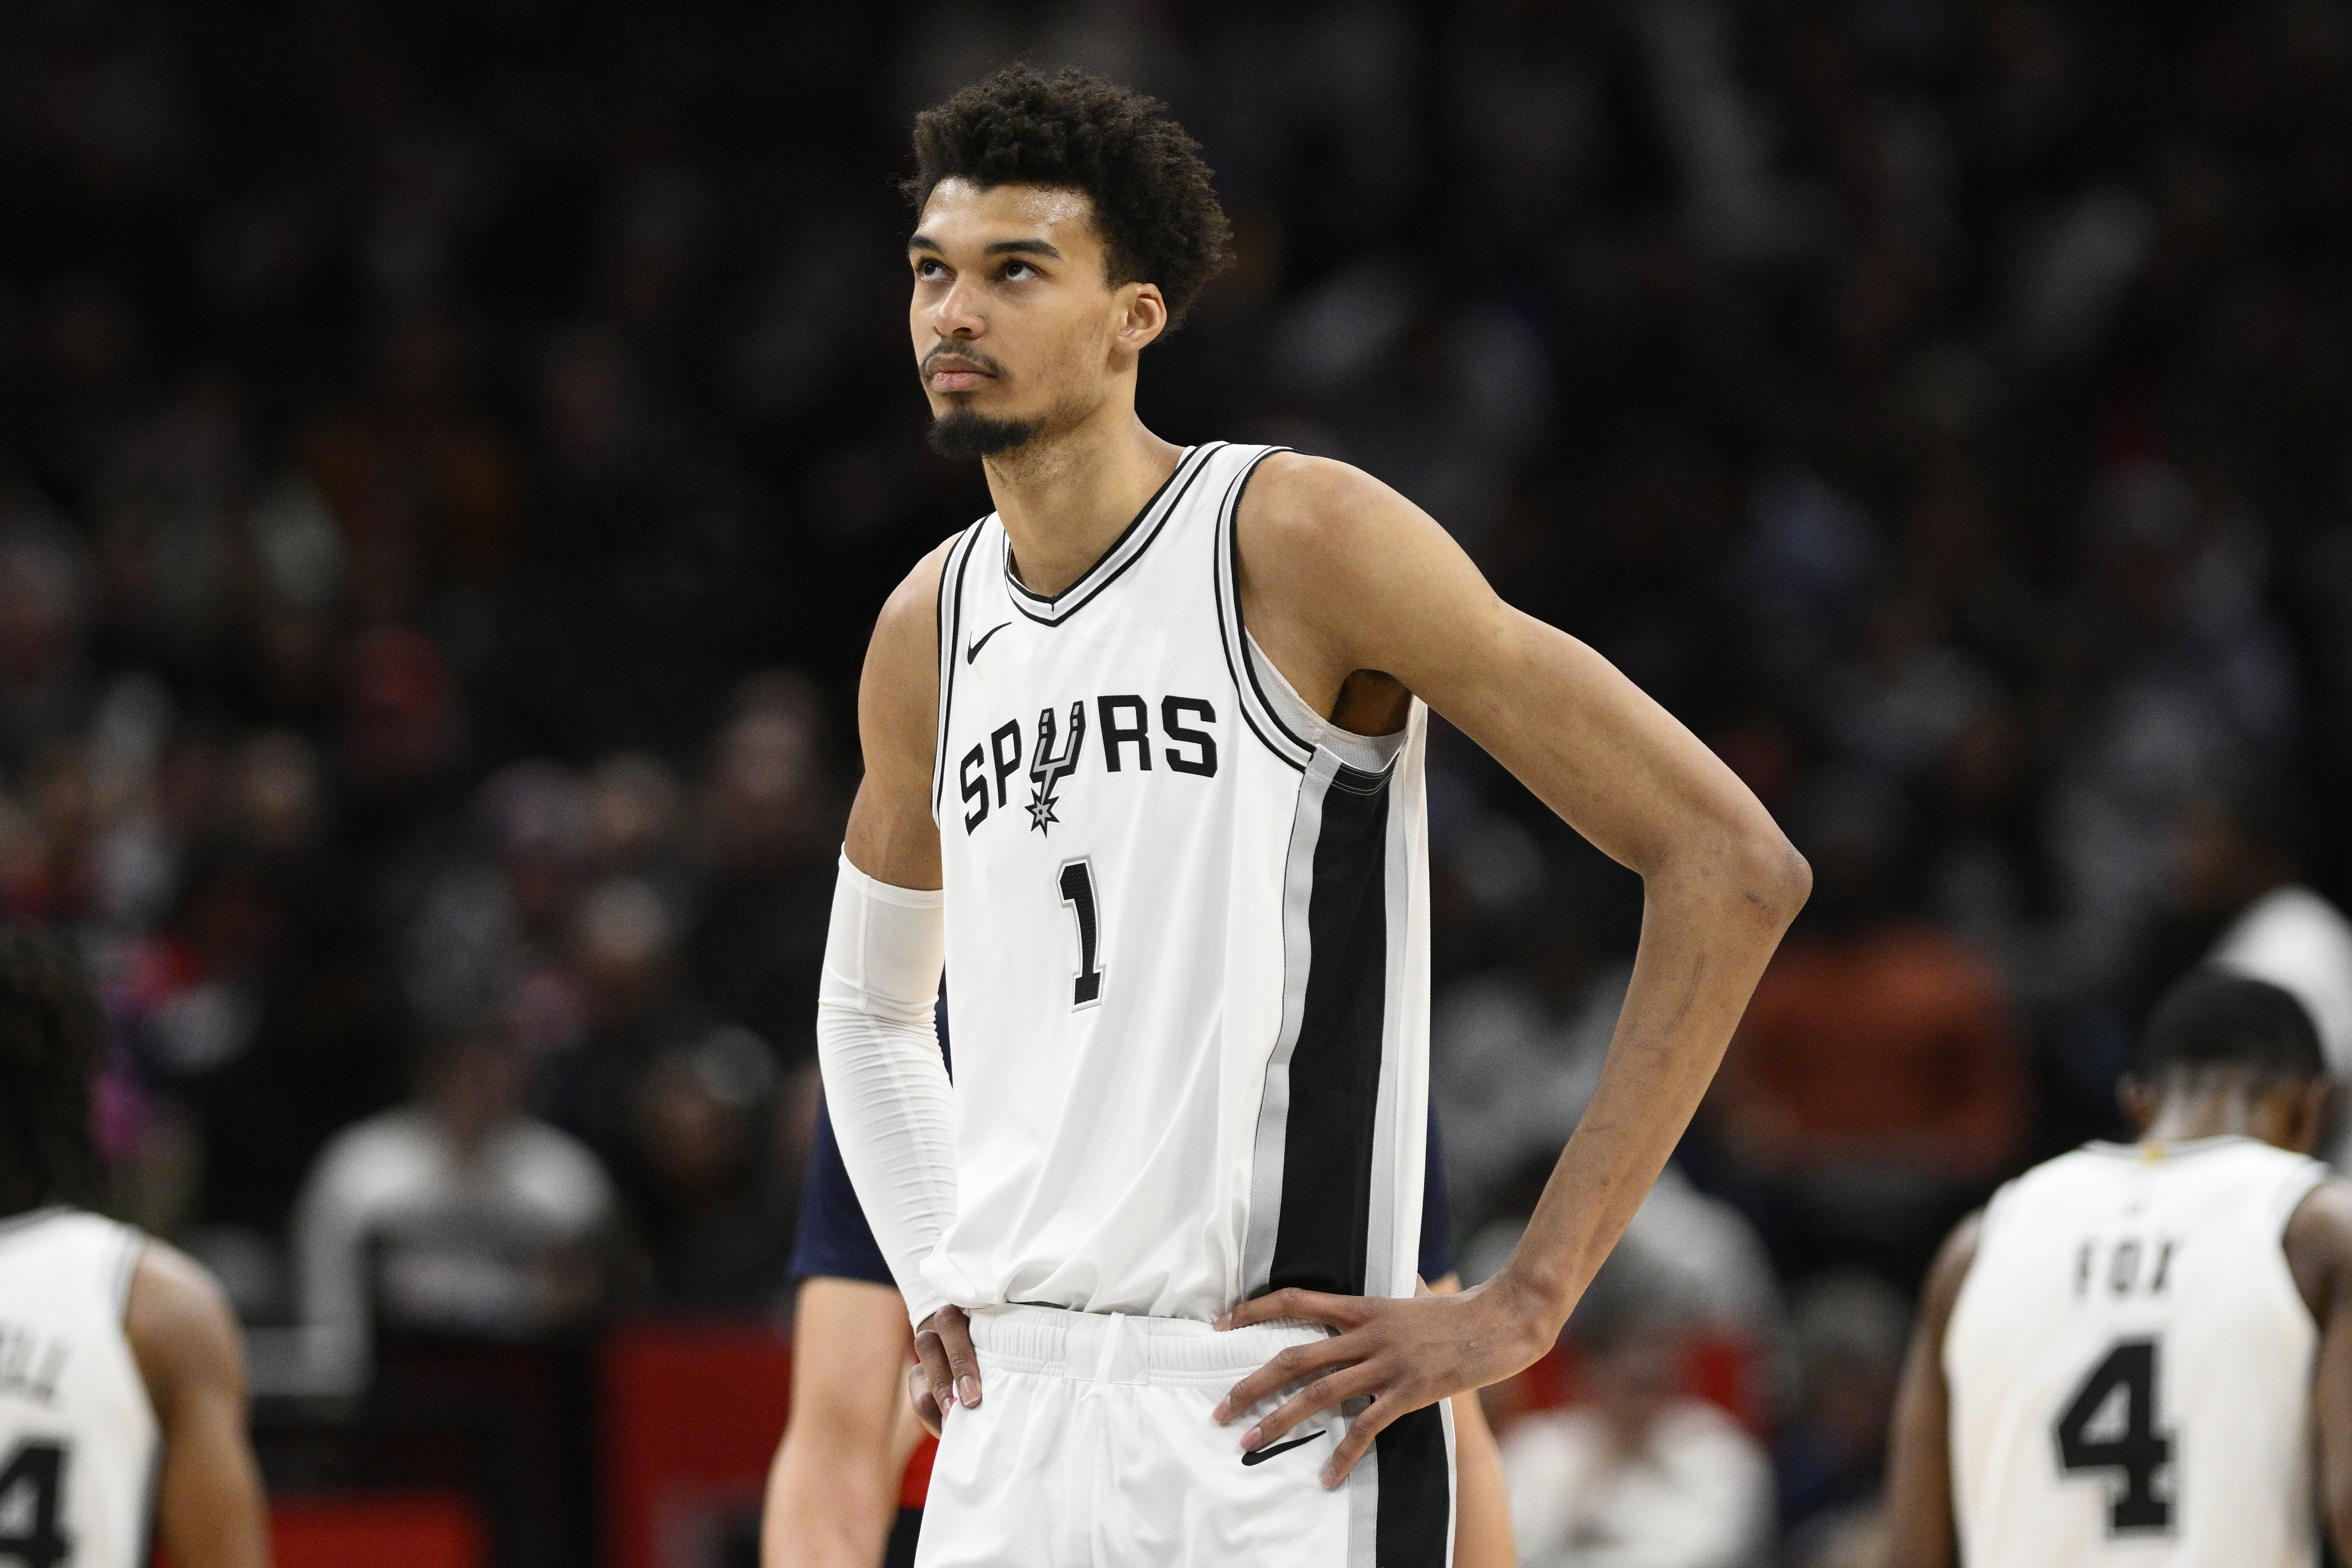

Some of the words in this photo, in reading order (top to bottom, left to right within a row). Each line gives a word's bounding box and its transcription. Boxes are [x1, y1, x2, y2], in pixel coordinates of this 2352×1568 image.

[960, 694, 1218, 839] SPURS
[1056, 855, 1106, 1014] 1
[2073, 1234, 2183, 1301] FOX
[2053, 1337, 2174, 1537] 4
